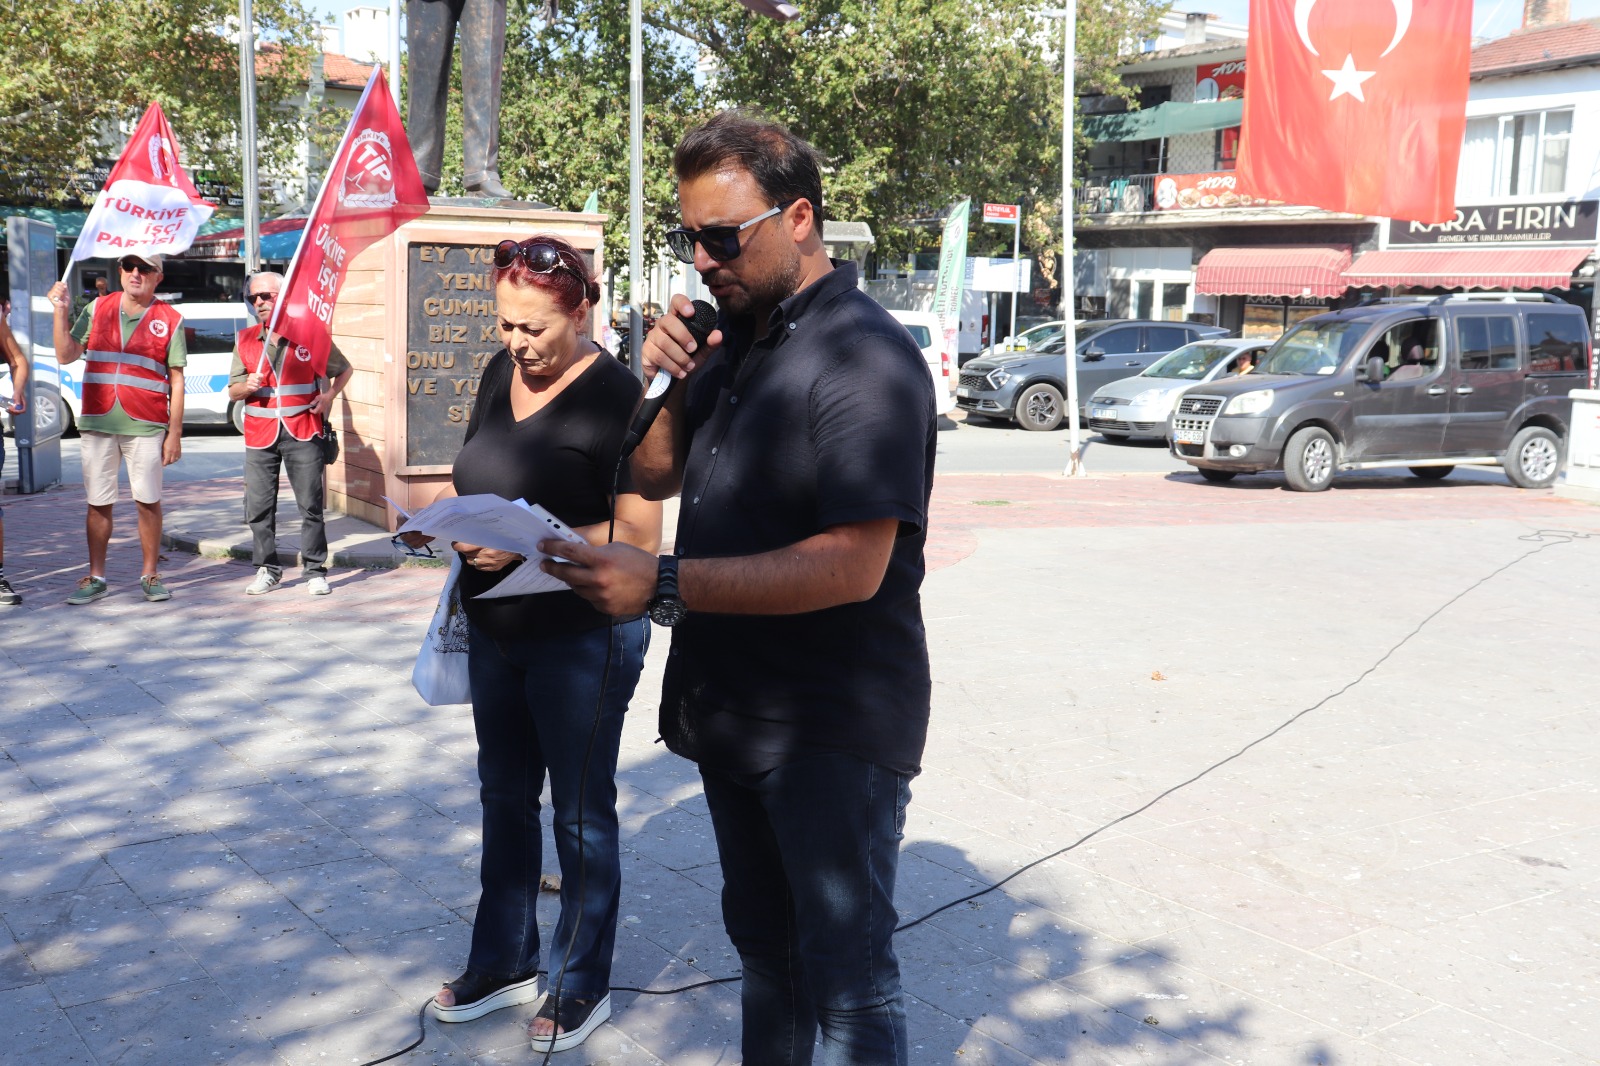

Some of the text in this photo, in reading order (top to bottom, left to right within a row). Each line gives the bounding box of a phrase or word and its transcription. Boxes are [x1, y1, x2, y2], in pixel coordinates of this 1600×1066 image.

[357, 143, 391, 181] TİP
[104, 197, 188, 221] TÜRKİYE
[1497, 205, 1576, 230] FIRIN
[144, 219, 183, 237] İŞÇİ
[420, 245, 450, 263] EY
[318, 259, 339, 297] İŞÇİ
[437, 269, 491, 291] YENİ
[429, 320, 467, 343] BİZ
[407, 350, 455, 370] ONU
[407, 377, 437, 395] VE
